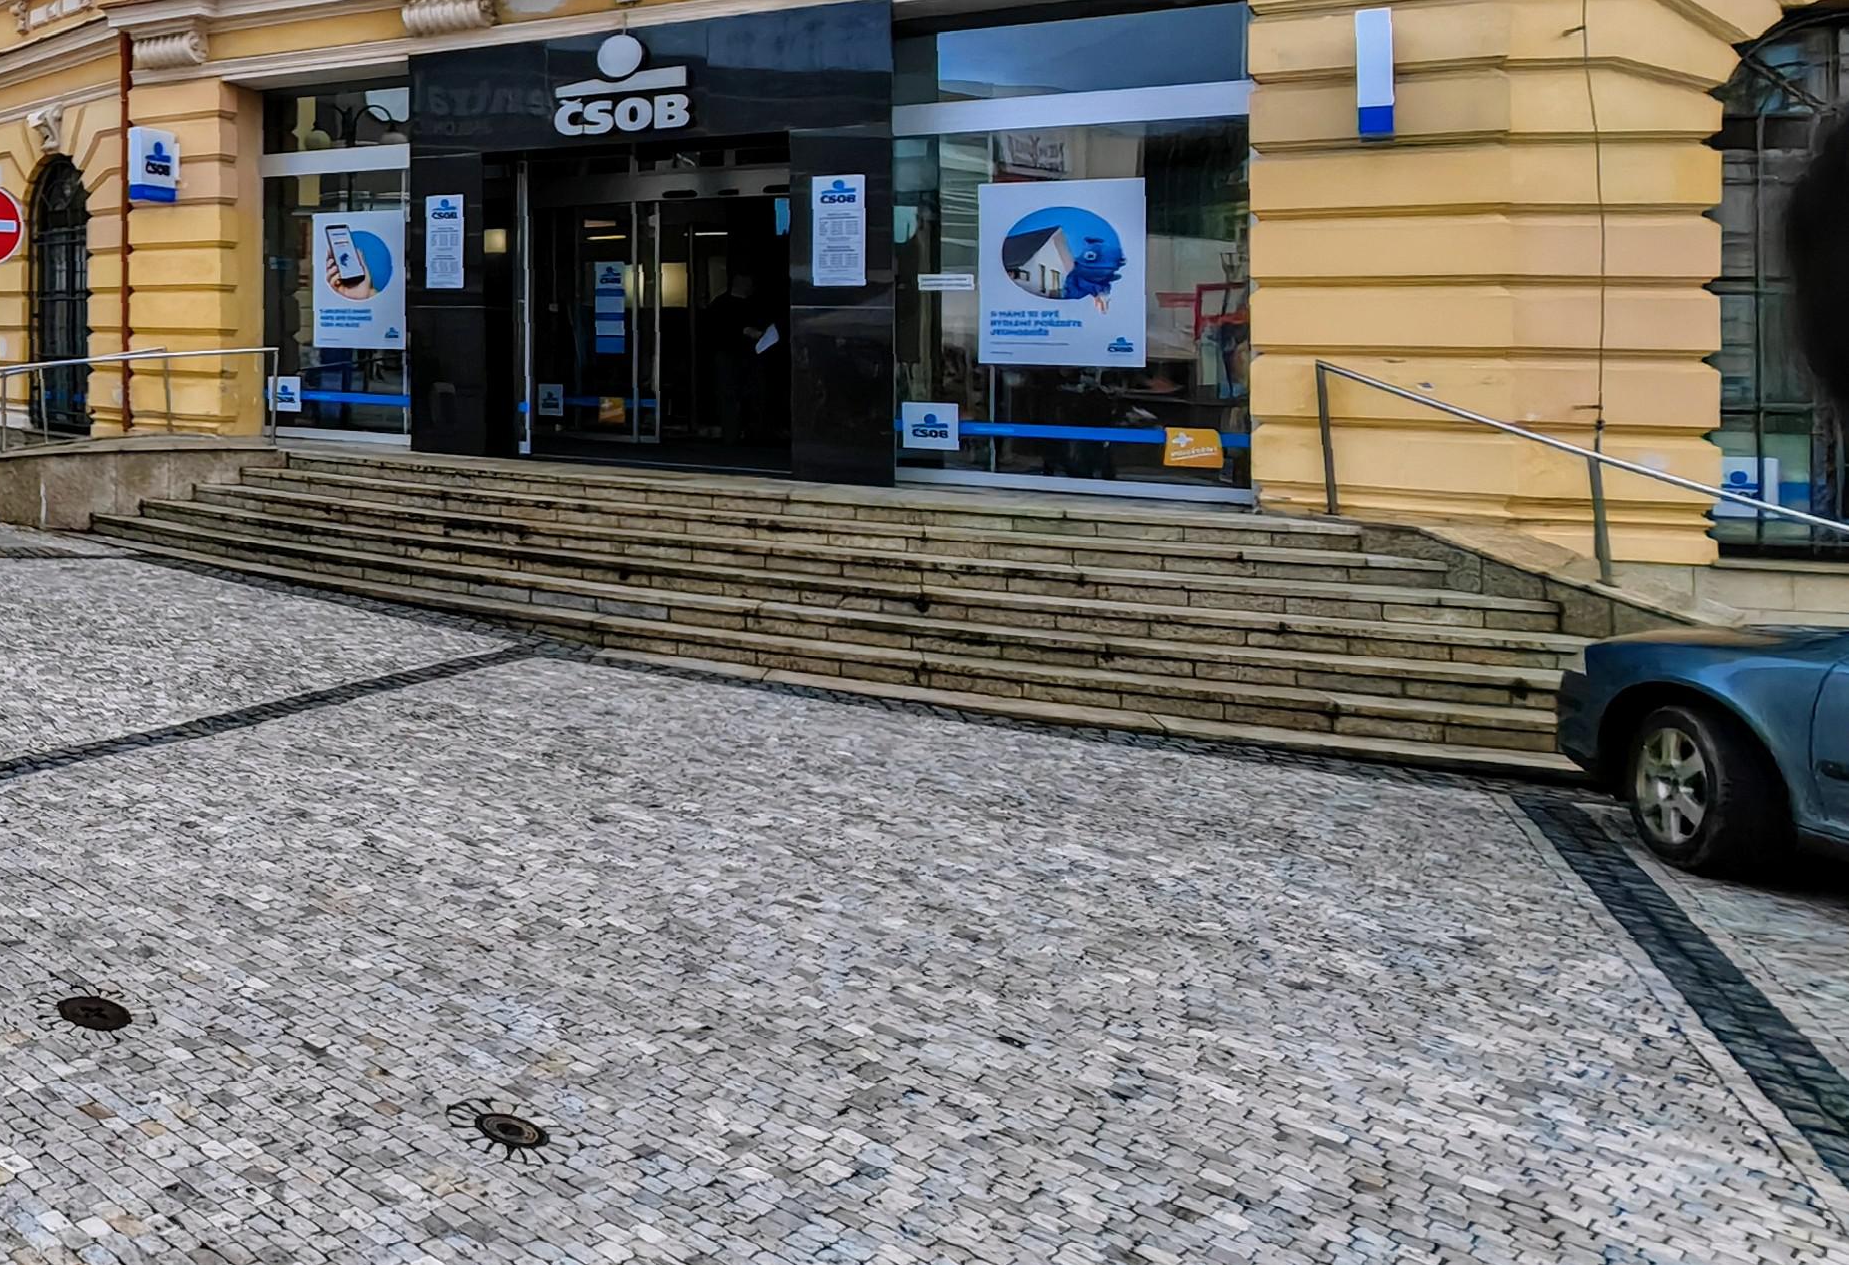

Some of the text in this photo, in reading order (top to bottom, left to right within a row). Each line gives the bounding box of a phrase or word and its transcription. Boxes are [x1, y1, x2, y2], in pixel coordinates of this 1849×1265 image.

[554, 94, 690, 136] ČSOB
[145, 160, 171, 177] ČSOB
[911, 428, 949, 439] ČSOB
